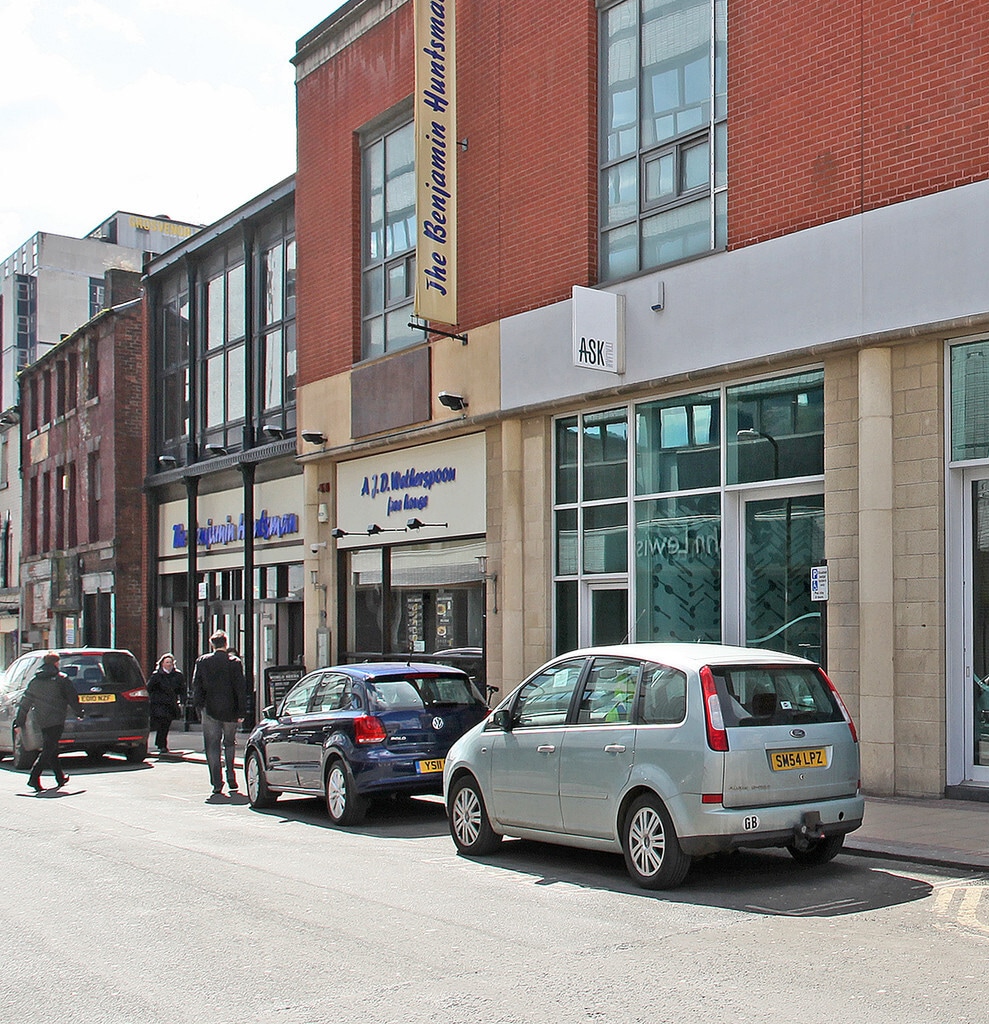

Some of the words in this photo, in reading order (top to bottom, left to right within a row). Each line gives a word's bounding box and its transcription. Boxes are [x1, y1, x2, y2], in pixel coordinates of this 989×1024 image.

[423, 120, 451, 244] Benjamin
[424, 253, 448, 297] The
[578, 336, 606, 367] ASK
[775, 752, 802, 768] SM54
[803, 751, 823, 765] LPZ
[744, 816, 758, 830] GB
